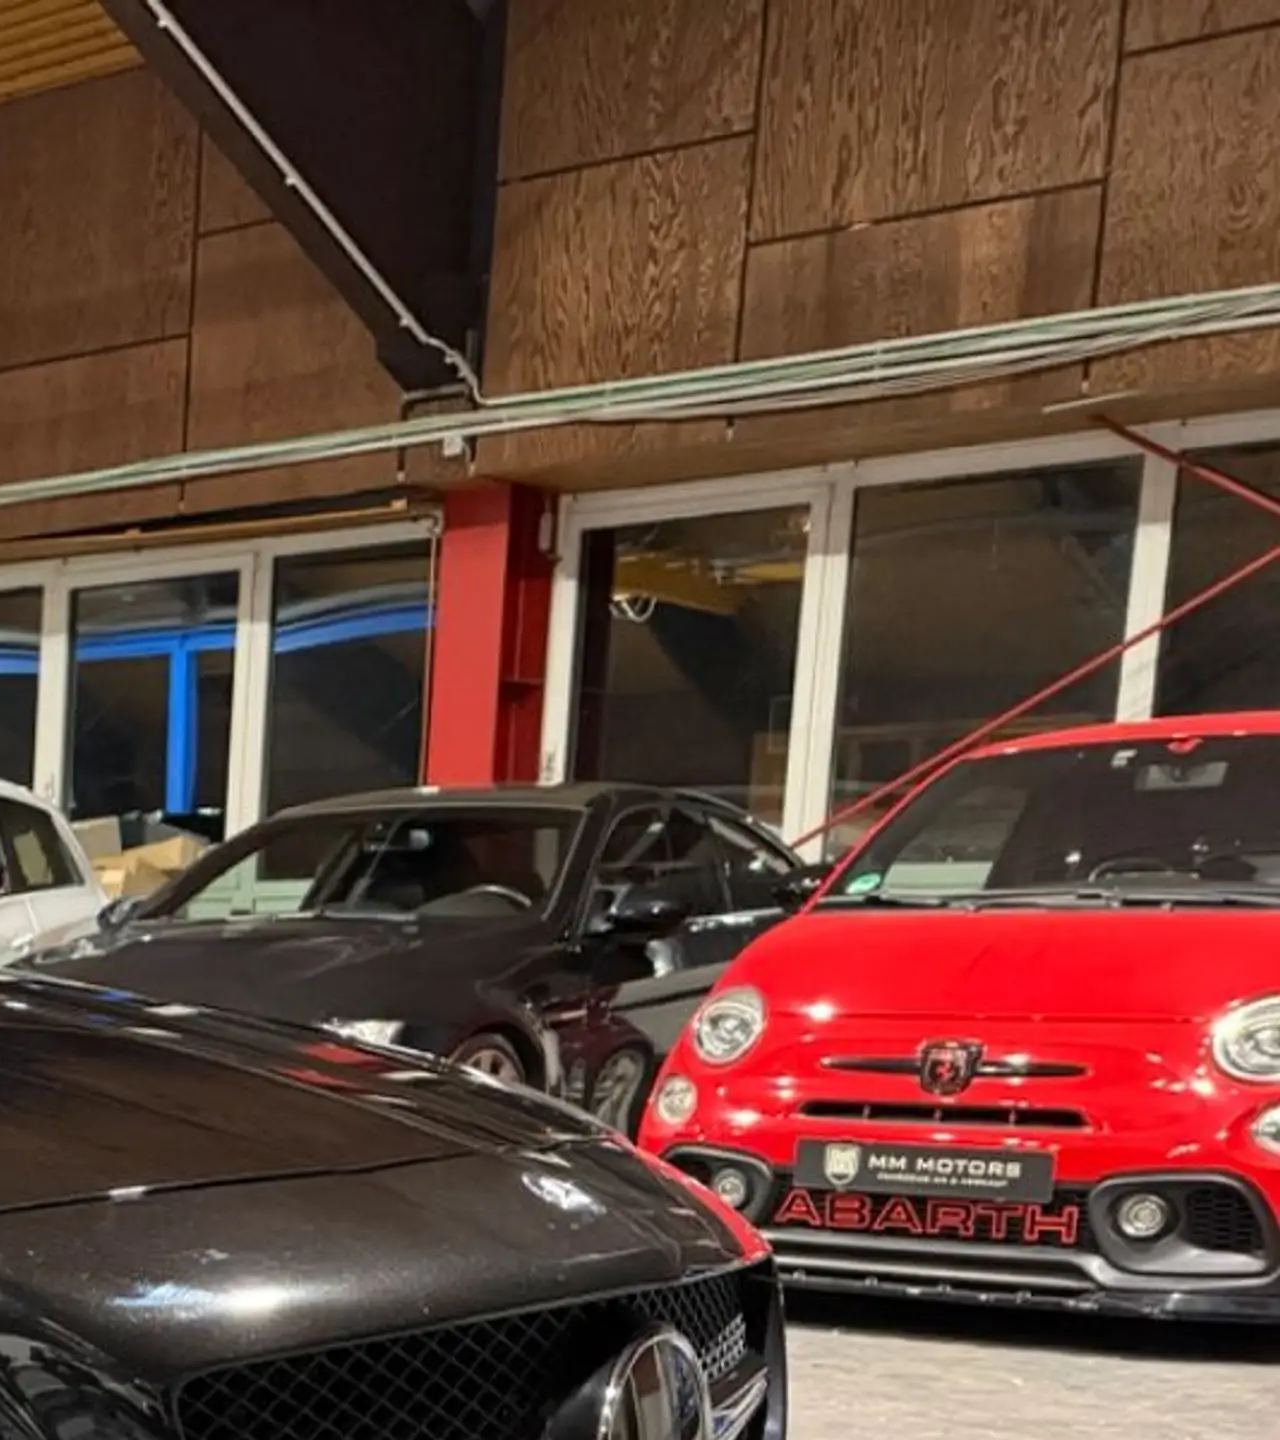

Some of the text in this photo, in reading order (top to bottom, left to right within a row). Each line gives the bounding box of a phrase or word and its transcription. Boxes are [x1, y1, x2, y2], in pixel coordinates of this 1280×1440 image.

[867, 1153, 1022, 1179] MM MOTORS
[774, 1189, 1080, 1244] ABARTH
